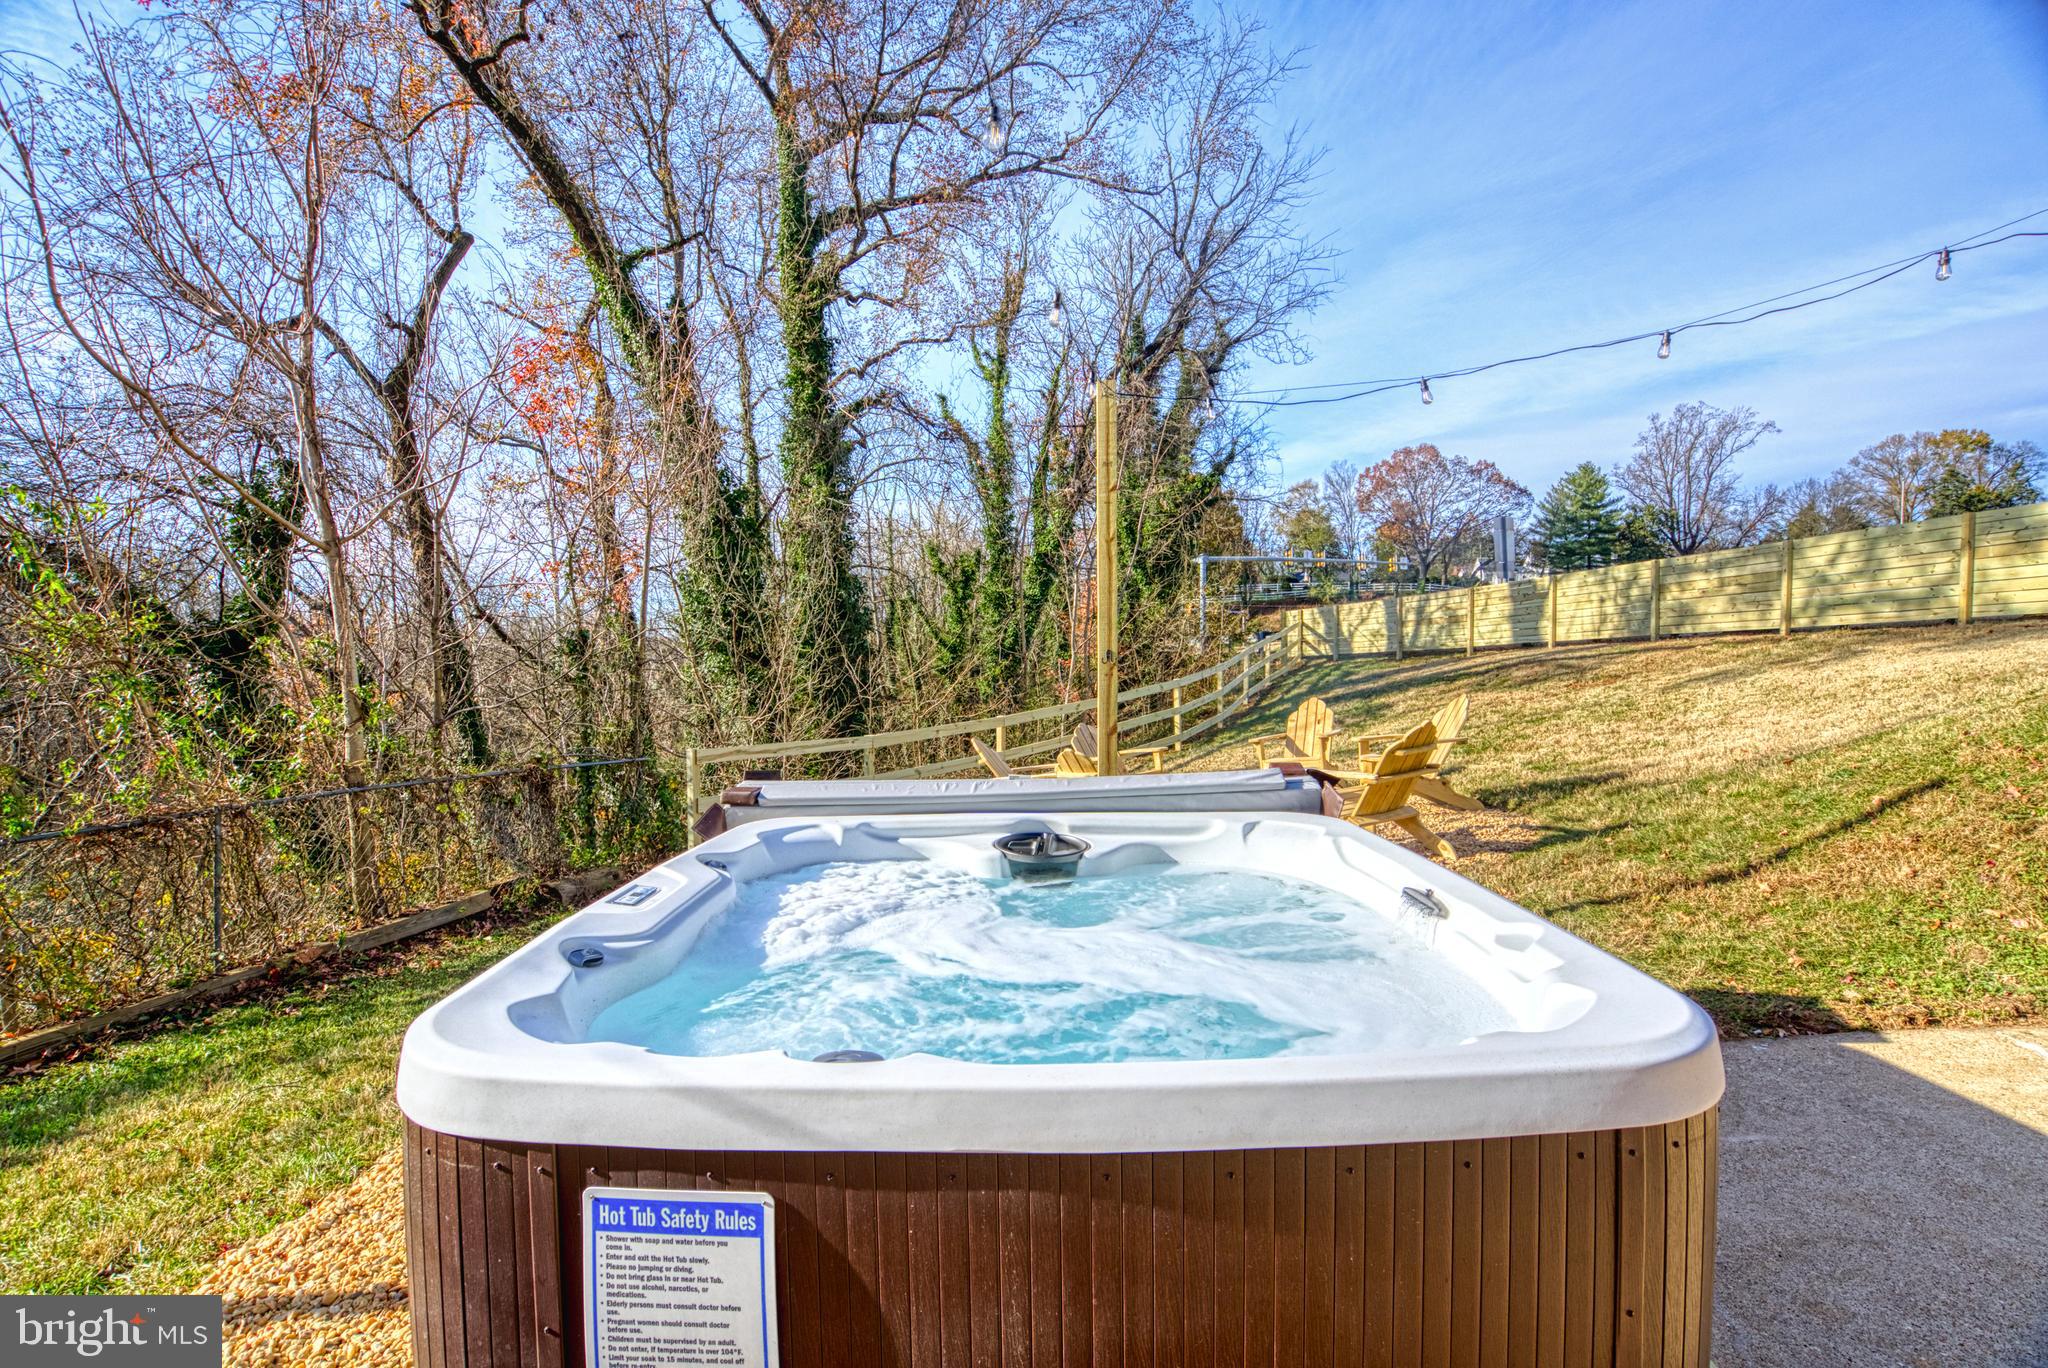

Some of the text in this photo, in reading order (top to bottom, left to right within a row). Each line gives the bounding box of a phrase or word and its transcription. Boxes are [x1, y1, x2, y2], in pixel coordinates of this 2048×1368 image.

[599, 1204, 756, 1233] Hot Tub Safety Rules
[606, 1235, 628, 1243] Shower
[630, 1236, 643, 1244] with
[689, 1257, 710, 1265] slowly.
[638, 1265, 663, 1273] jumping
[673, 1266, 694, 1274] diving.
[628, 1274, 644, 1282] bring
[646, 1274, 663, 1282] glass
[642, 1284, 666, 1292] alcohol,
[668, 1285, 700, 1293] narcotics,
[607, 1301, 627, 1309] Elderly
[607, 1319, 635, 1327] Pregnant
[608, 1335, 634, 1343] Children
[663, 1337, 697, 1345] supervised
[657, 1347, 697, 1355] temperature
